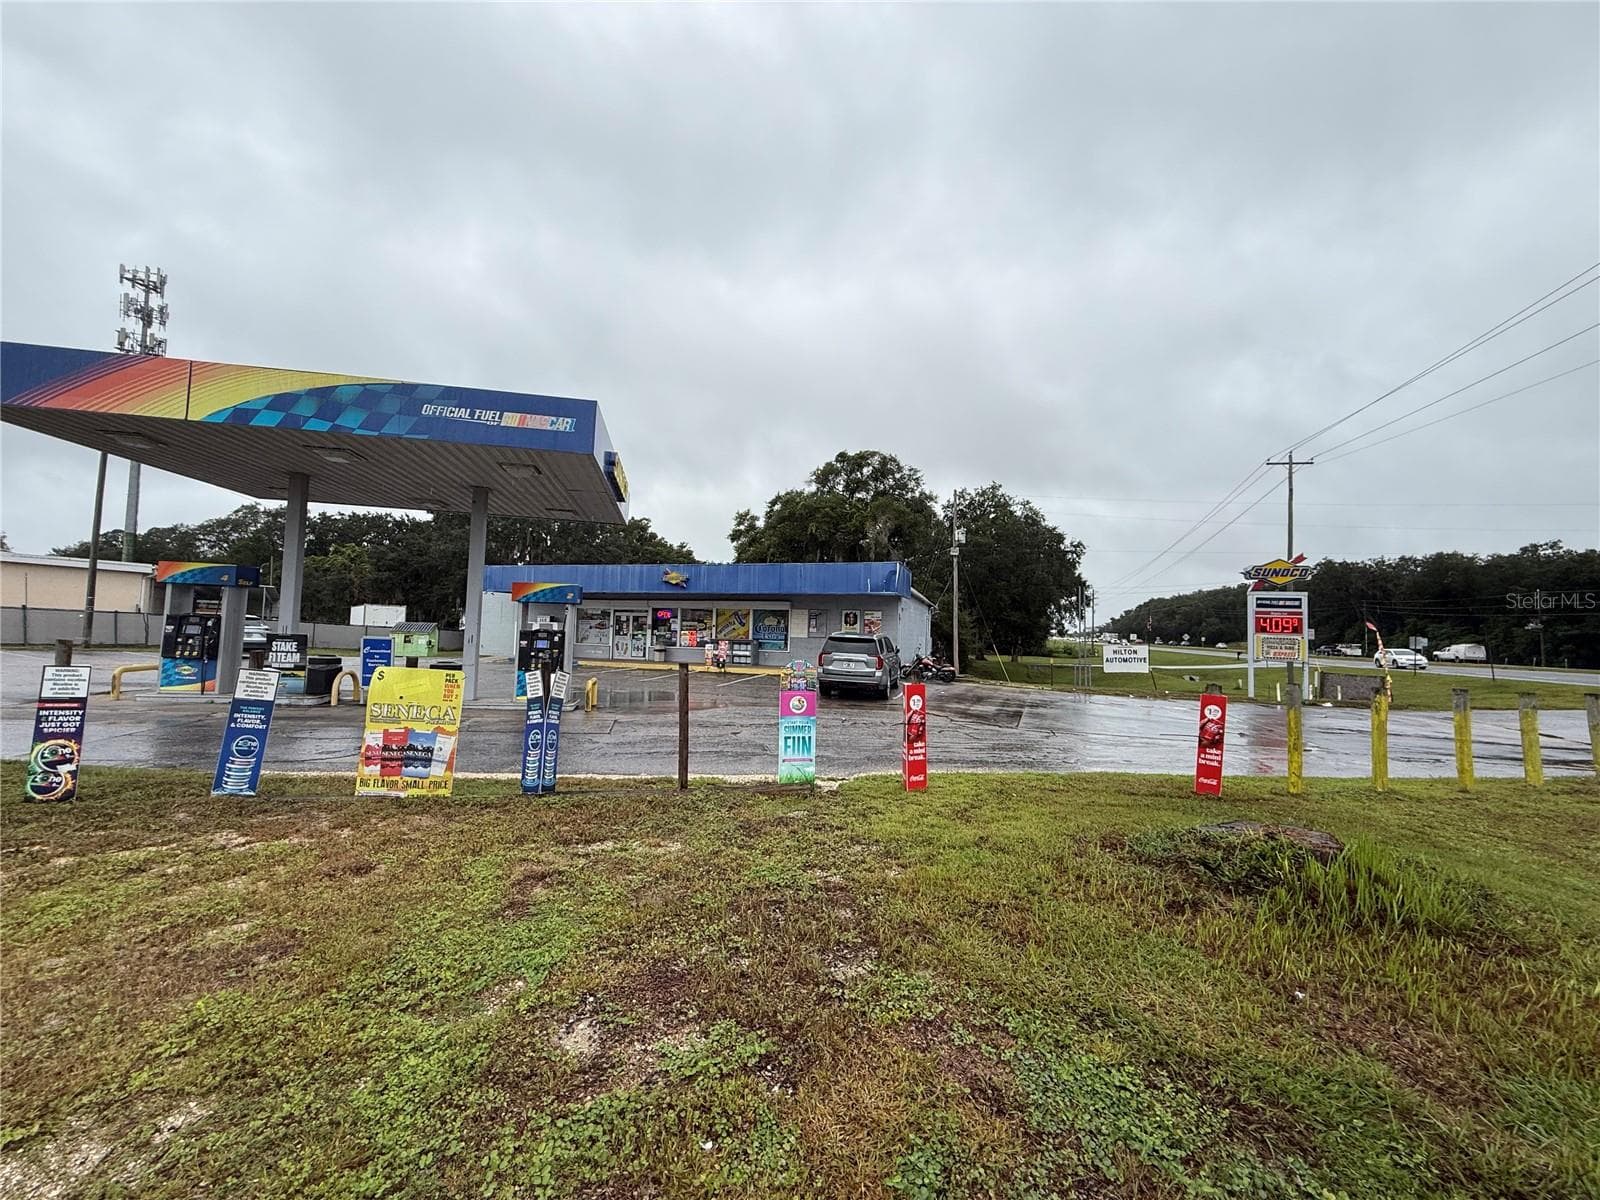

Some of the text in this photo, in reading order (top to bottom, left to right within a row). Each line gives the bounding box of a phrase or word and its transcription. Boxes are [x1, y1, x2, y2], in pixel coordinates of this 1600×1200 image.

[421, 403, 472, 421] OFFICIAL
[474, 409, 501, 422] FUEL
[1252, 567, 1309, 577] SUNOCO
[753, 622, 785, 634] Corona
[271, 641, 298, 652] STAKE
[277, 652, 300, 663] TEAM
[370, 703, 456, 721] SENECA
[783, 725, 812, 735] SUMMER
[783, 735, 812, 757] FUN
[1198, 758, 1221, 767] break.
[359, 778, 449, 791] BIG FLAVOR SMALL PRICE
